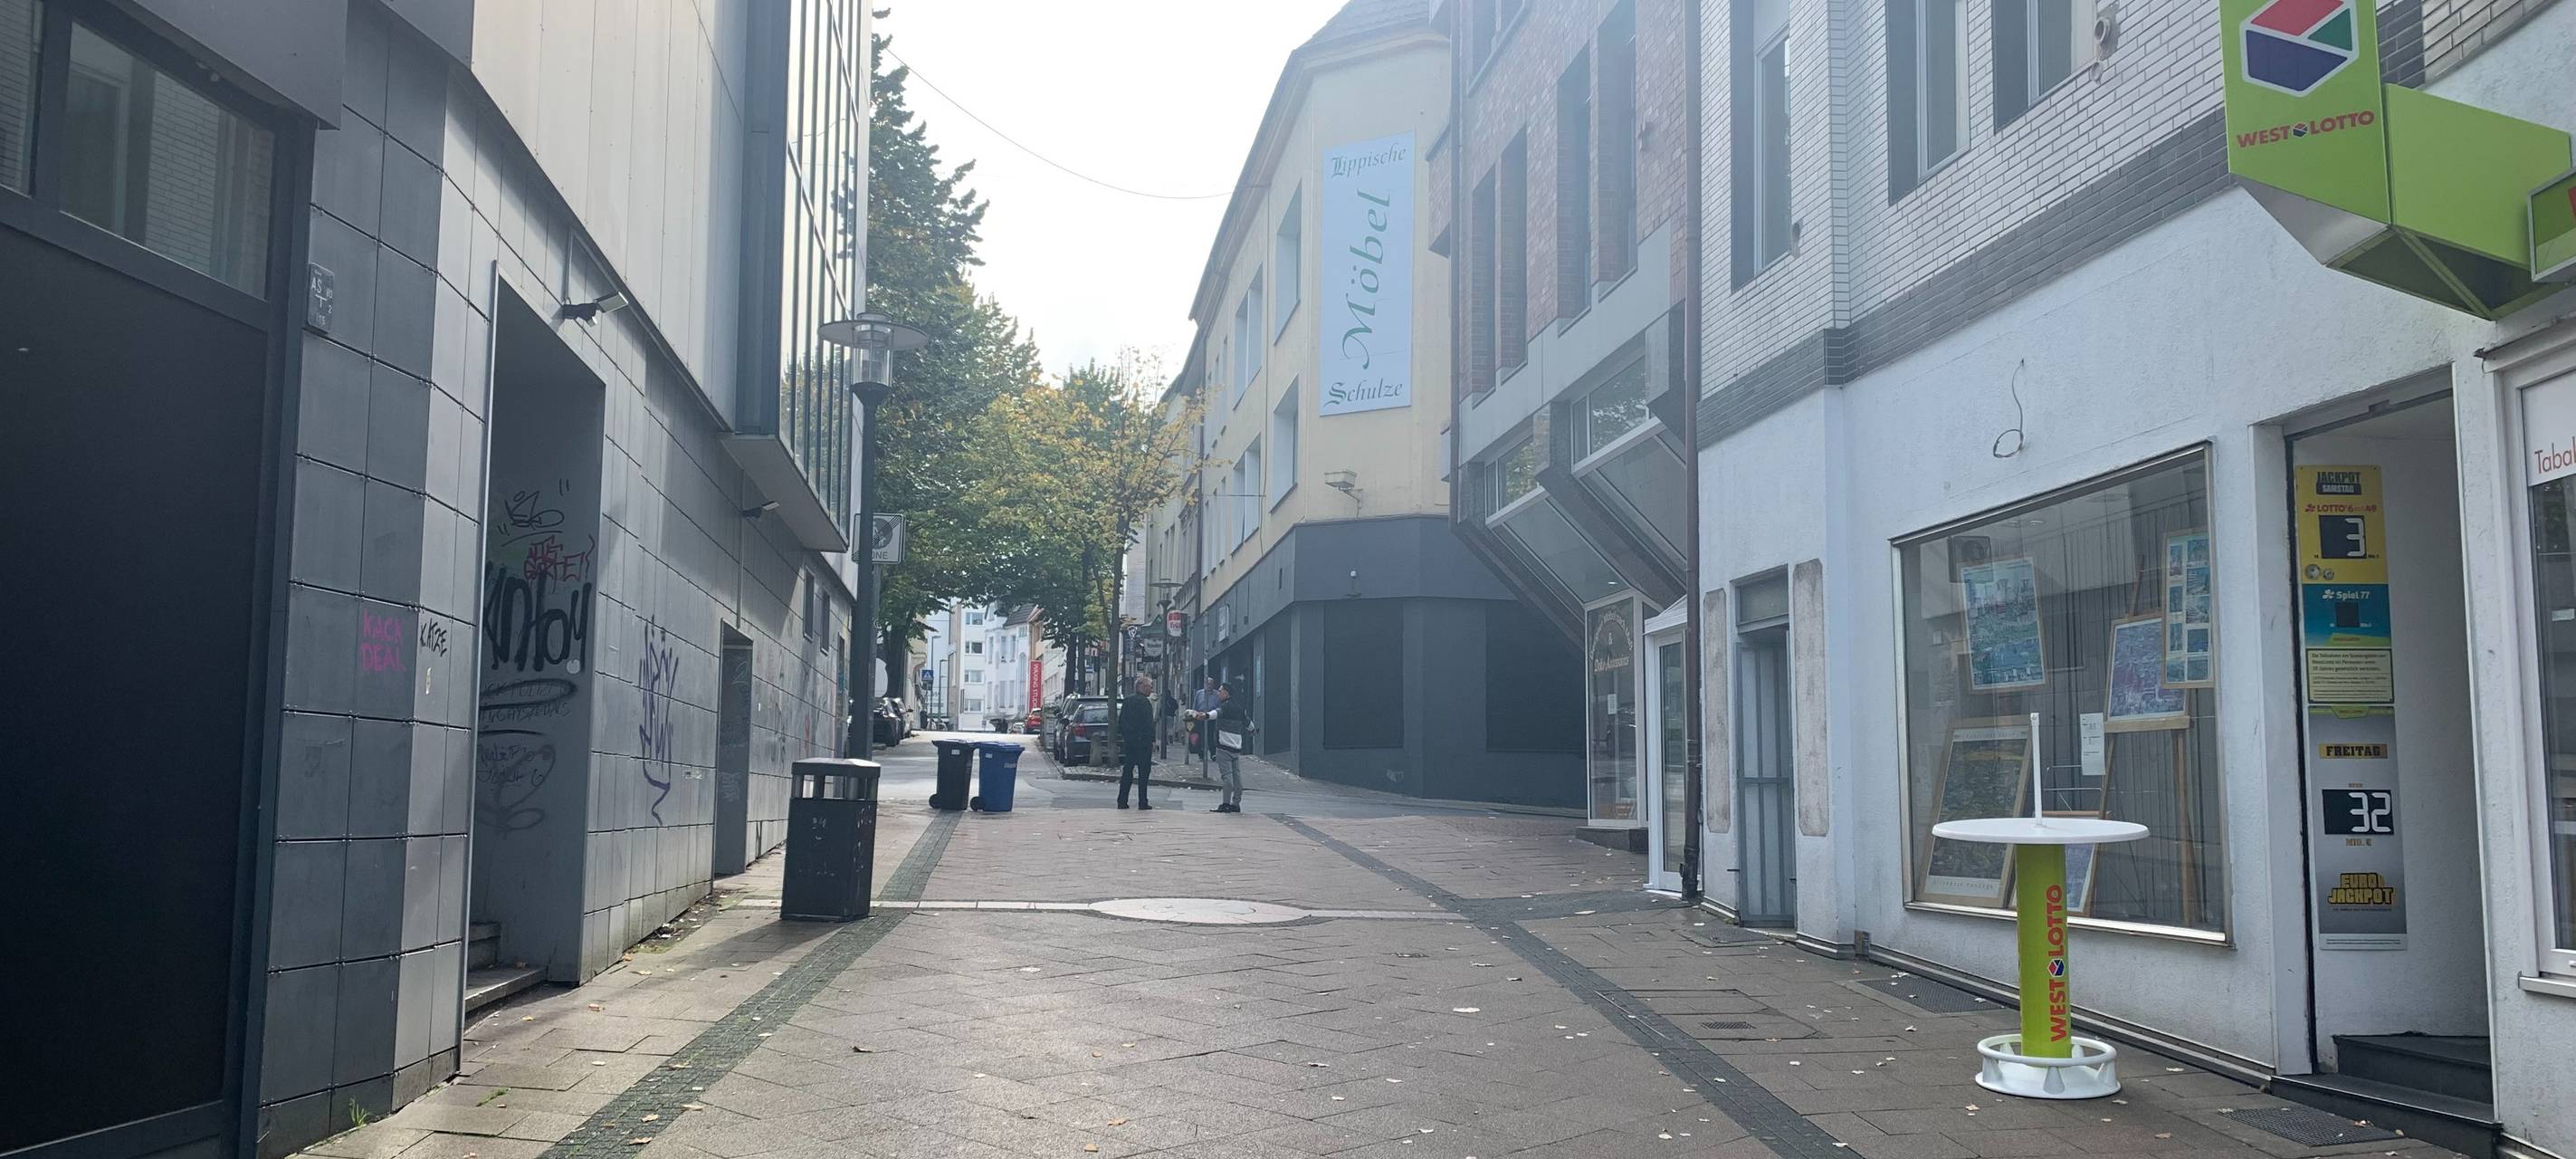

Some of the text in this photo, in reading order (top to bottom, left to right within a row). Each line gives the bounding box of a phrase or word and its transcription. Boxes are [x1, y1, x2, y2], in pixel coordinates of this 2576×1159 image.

[2237, 110, 2376, 148] WEST LOTTO
[1331, 142, 1407, 178] Lippische
[1341, 187, 1391, 370] Möbel
[1323, 378, 1404, 407] Schulze
[2317, 472, 2361, 484] JACKPOT
[2317, 503, 2345, 513] LOTTO
[2344, 517, 2366, 557] 3
[2336, 590, 2371, 602] Spiel 77
[2326, 745, 2380, 757] FREITAG
[2348, 791, 2391, 833] 32
[2340, 873, 2379, 888] EURO
[2328, 887, 2393, 905] JACKPOT
[2046, 884, 2068, 1043] WEST LOTTO
